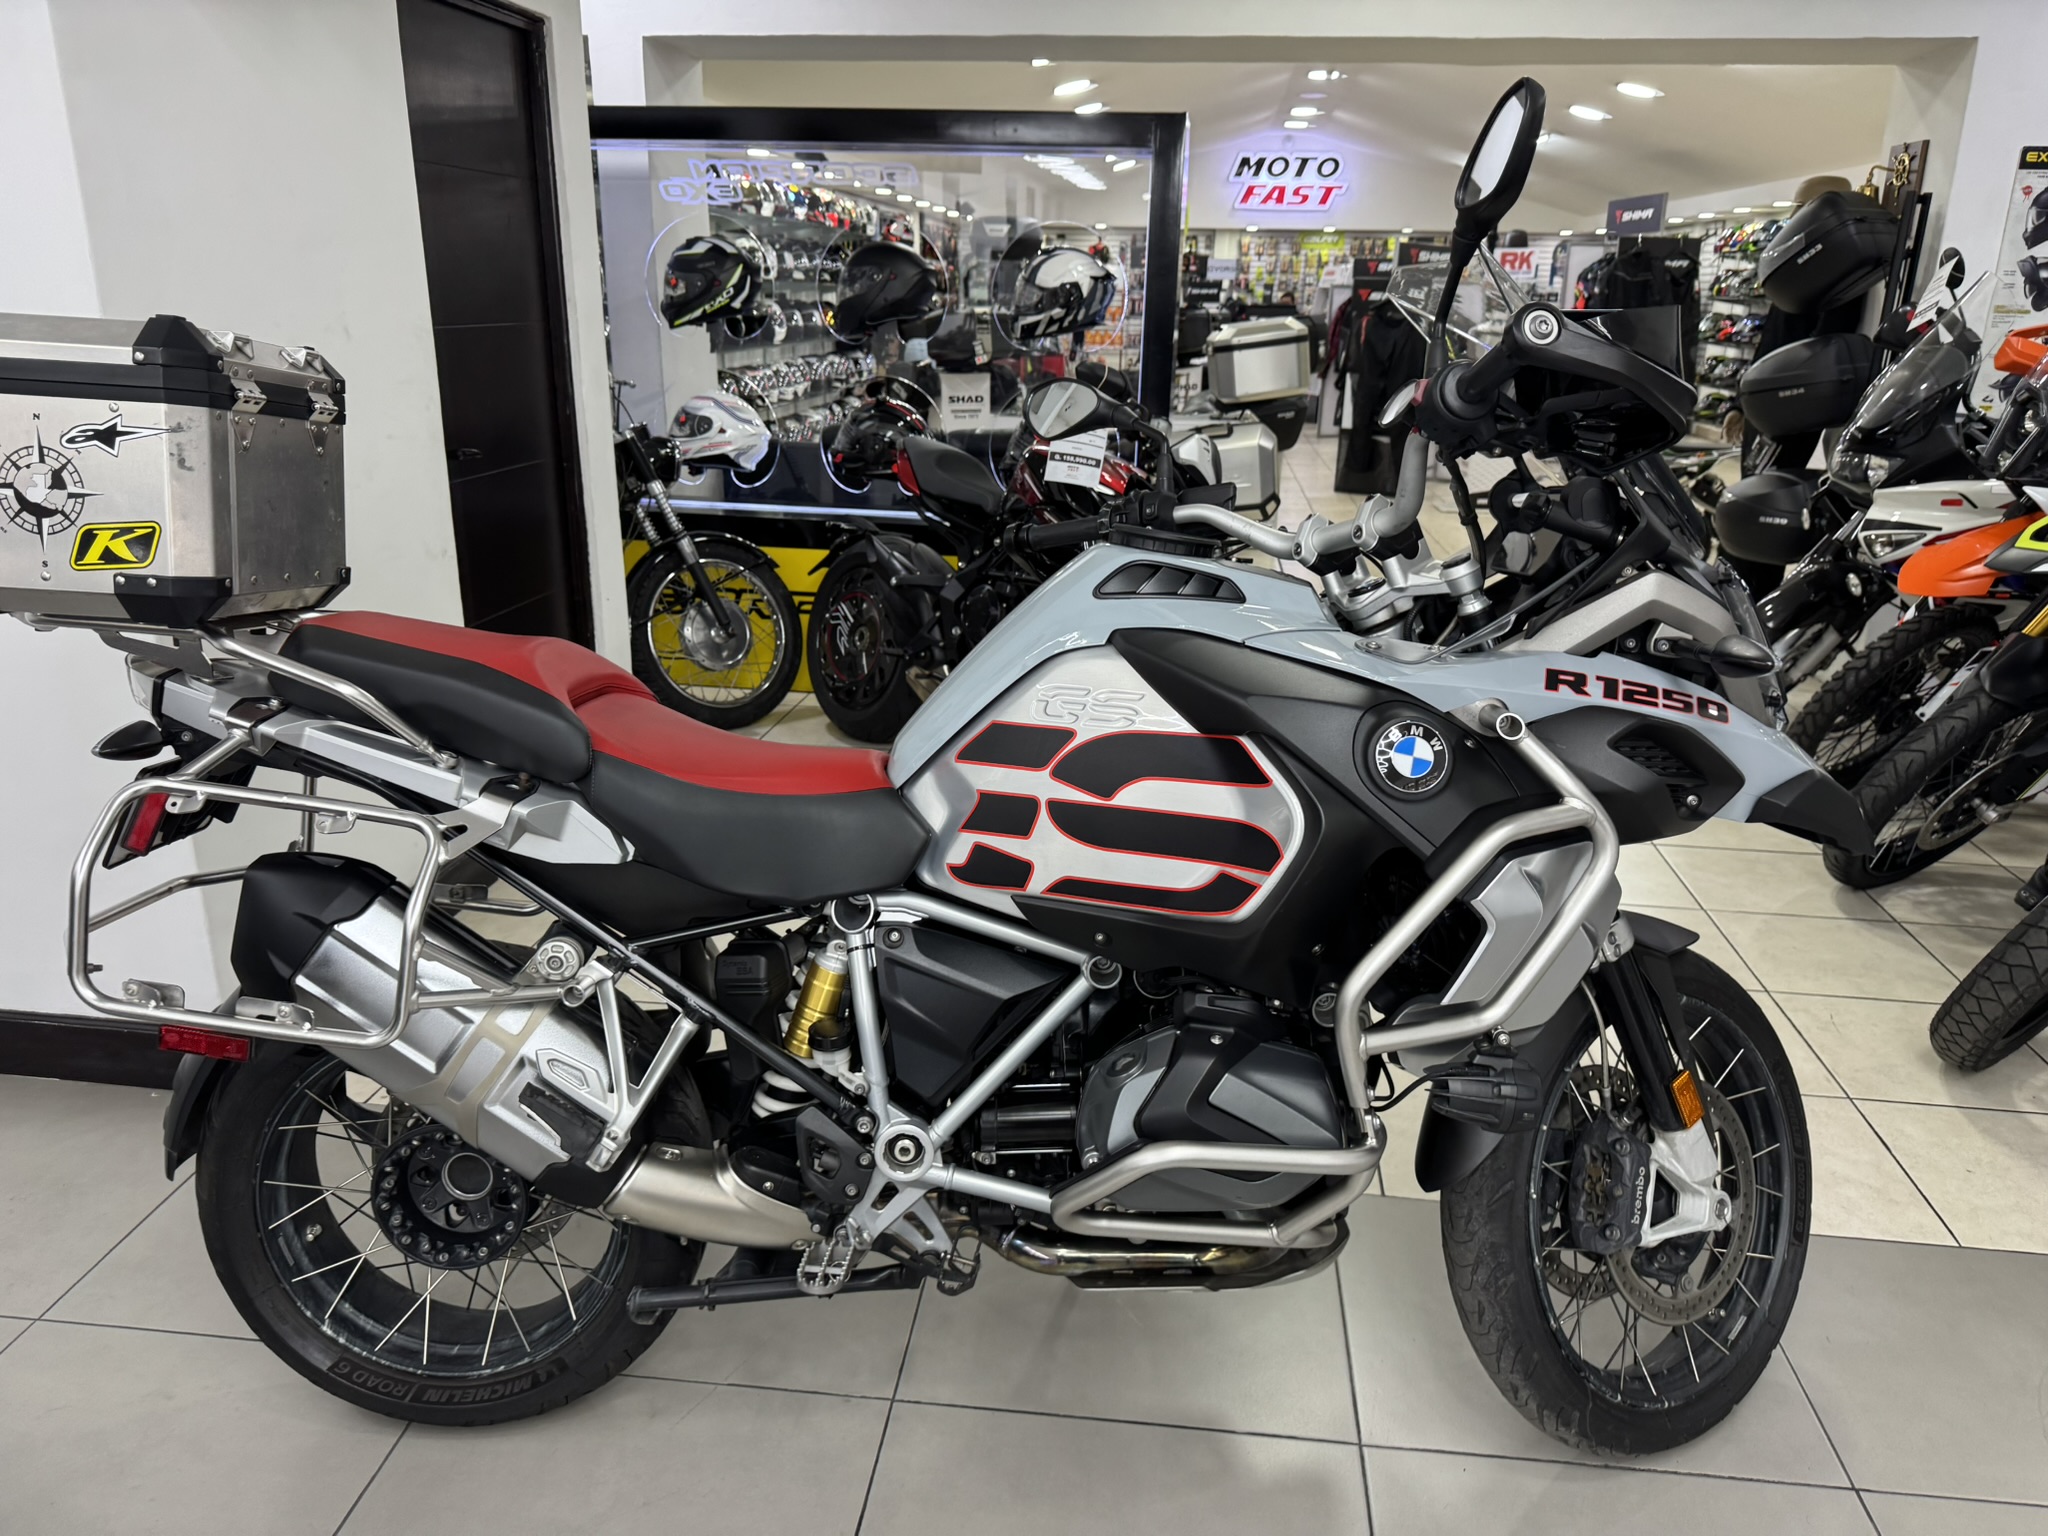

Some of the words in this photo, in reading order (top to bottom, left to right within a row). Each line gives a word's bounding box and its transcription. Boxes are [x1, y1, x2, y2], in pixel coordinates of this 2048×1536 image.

[1233, 156, 1340, 178] MOTO
[1239, 184, 1343, 206] FAST
[1501, 250, 1535, 271] RK
[948, 395, 984, 404] SHAD
[32, 412, 41, 421] N
[76, 528, 153, 565] K
[41, 560, 49, 568] S
[1030, 683, 1147, 730] GS
[1544, 668, 1592, 698] R
[1594, 675, 1731, 725] 1250
[1630, 1165, 1646, 1226] brembo
[333, 1360, 350, 1376] 6
[352, 1364, 409, 1397] ROAD
[422, 1376, 533, 1402] MICHELIN
